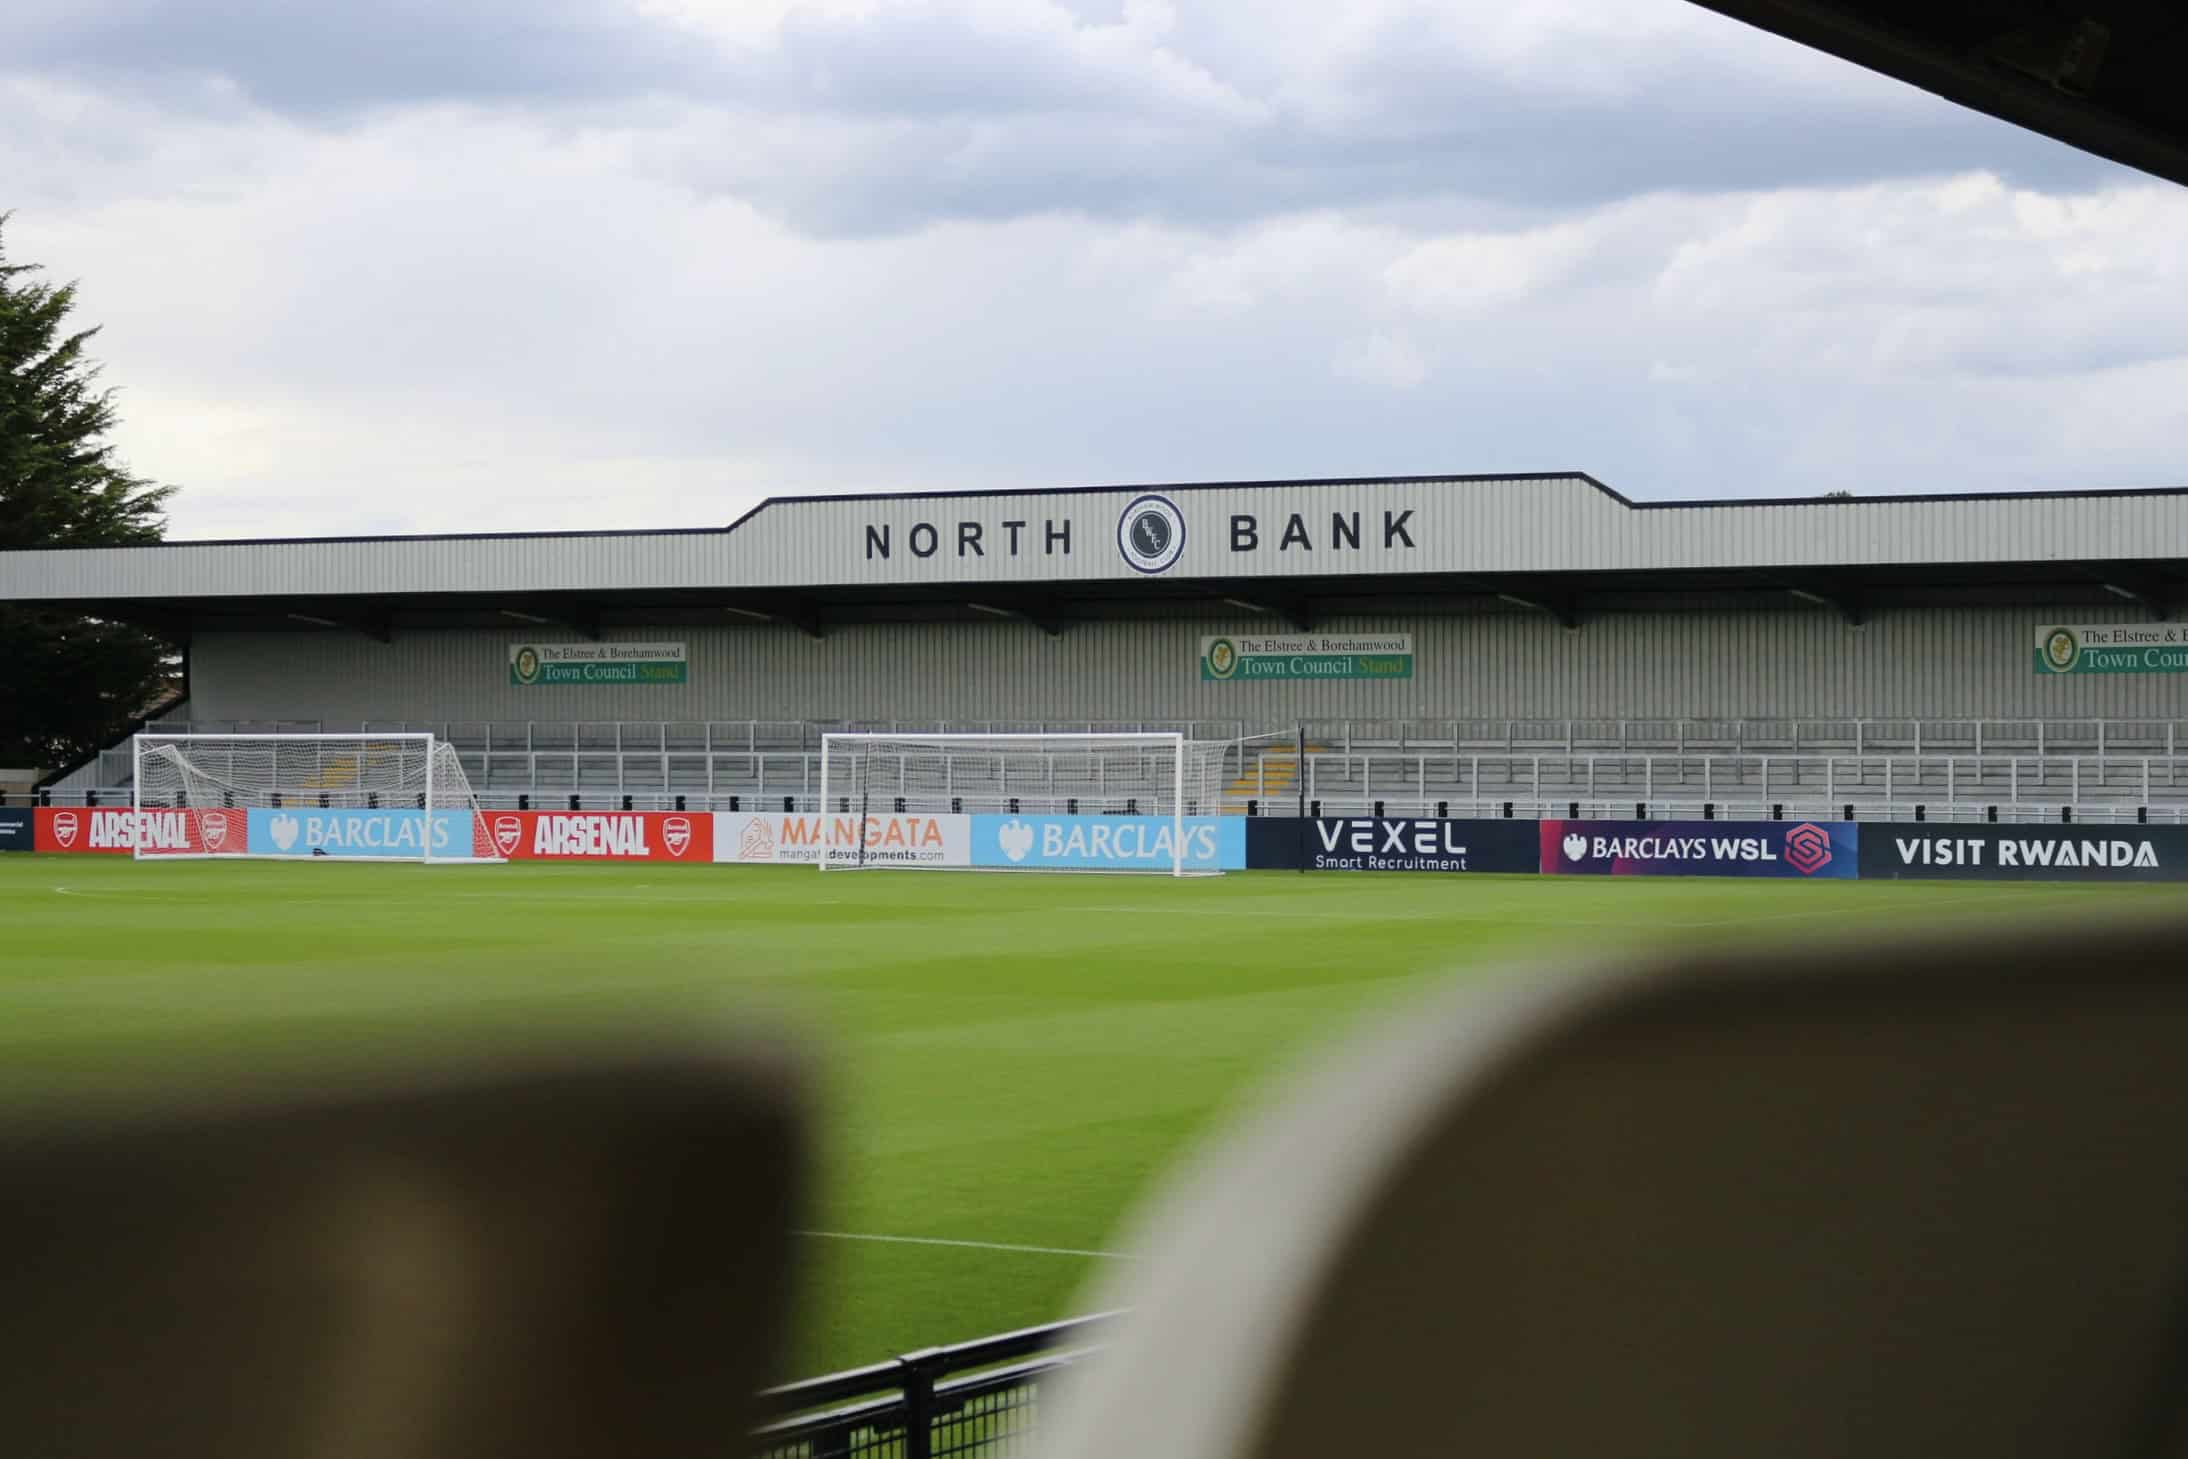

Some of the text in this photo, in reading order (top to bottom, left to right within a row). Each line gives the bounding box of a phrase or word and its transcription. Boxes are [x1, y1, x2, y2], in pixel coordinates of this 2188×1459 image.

[866, 510, 1416, 560] NORTH BANK
[1240, 638, 1406, 652] The Elstree & Borehamwood
[2083, 630, 2108, 643] The
[2113, 629, 2160, 643] Elstree
[2164, 628, 2177, 642] &
[543, 647, 680, 660] The Elstree & Borehamwood
[1241, 656, 1405, 675] Town Council Stand
[2083, 649, 2137, 668] Town
[544, 664, 580, 680] Town
[584, 663, 636, 680] Council
[89, 811, 190, 848] ARSENAL
[305, 817, 449, 848] BARCLAYS
[534, 815, 649, 855] ARSENAL
[1042, 823, 1216, 859] BARCLAYS
[1316, 820, 1467, 854] VEXEL
[1592, 836, 1777, 861] BARCLAYS WSL
[1896, 838, 2160, 867] VISIT RWANDA
[1315, 855, 1467, 870] Smart Recruitment
